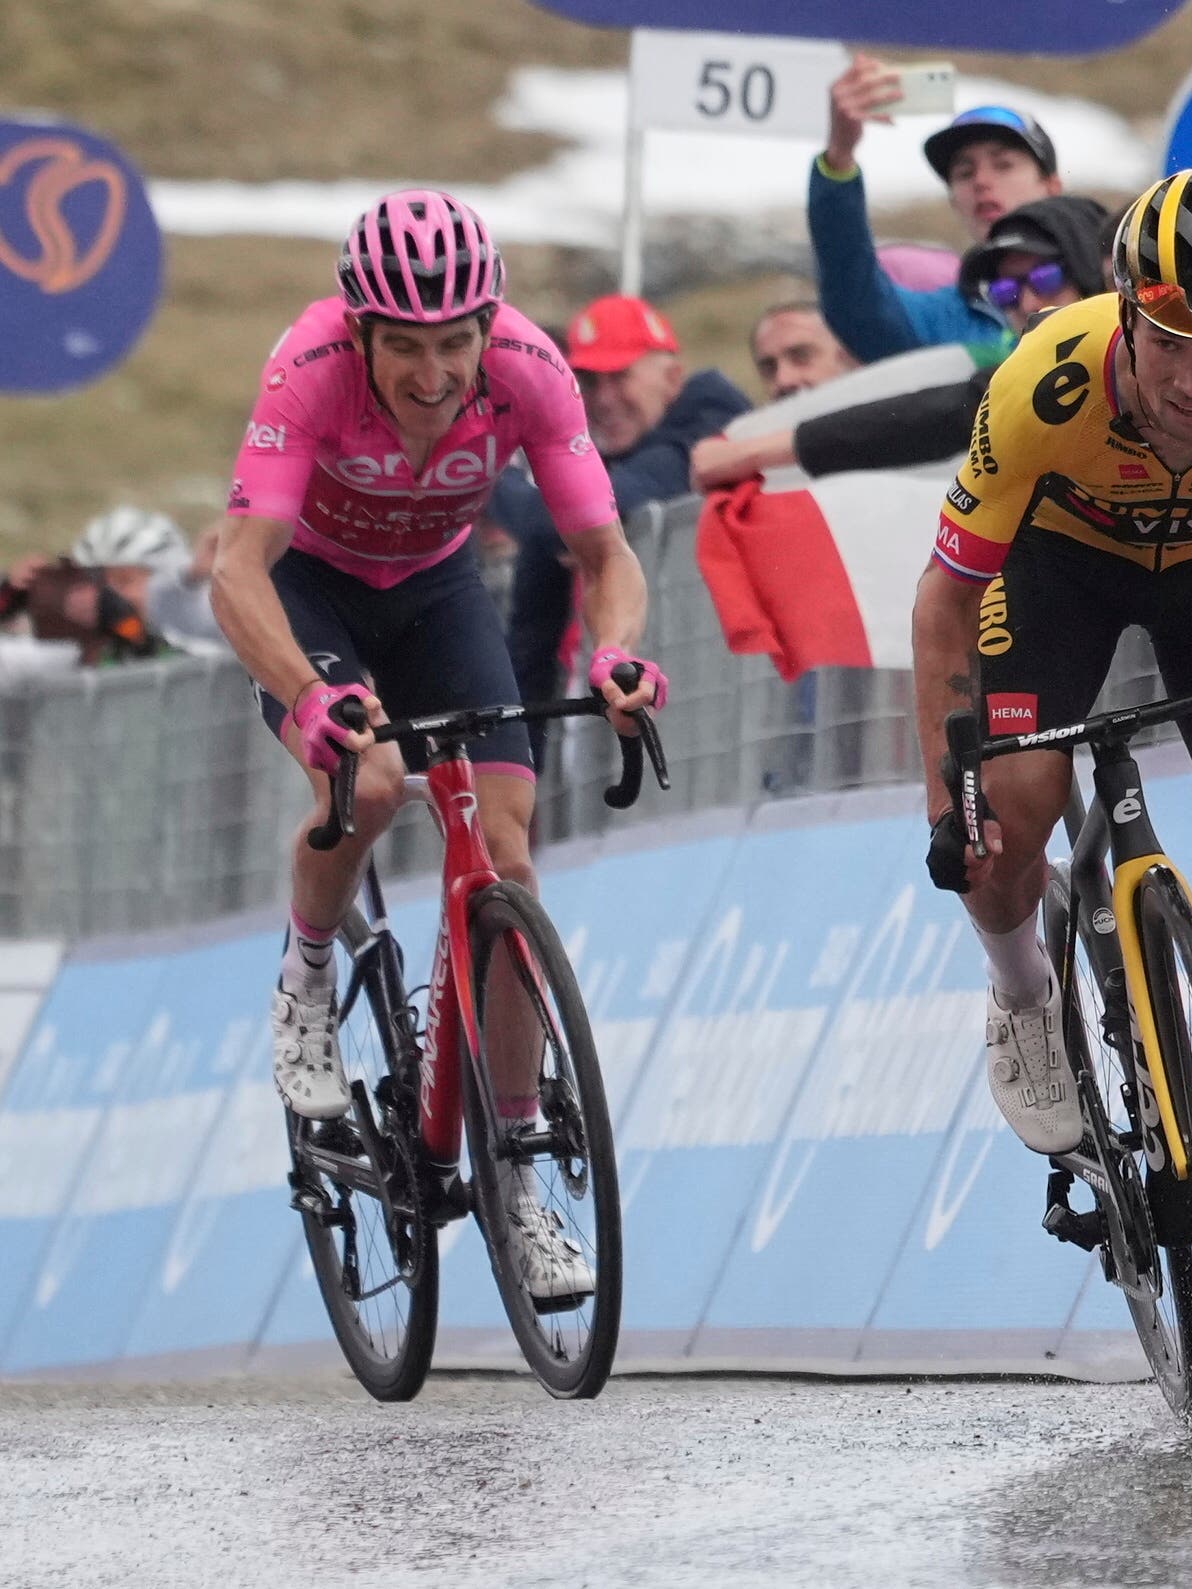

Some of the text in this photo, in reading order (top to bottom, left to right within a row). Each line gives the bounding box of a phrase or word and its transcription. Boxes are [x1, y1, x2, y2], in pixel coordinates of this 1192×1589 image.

[698, 61, 776, 121] 50
[991, 707, 1033, 719] HEMA
[963, 770, 980, 842] SRAM
